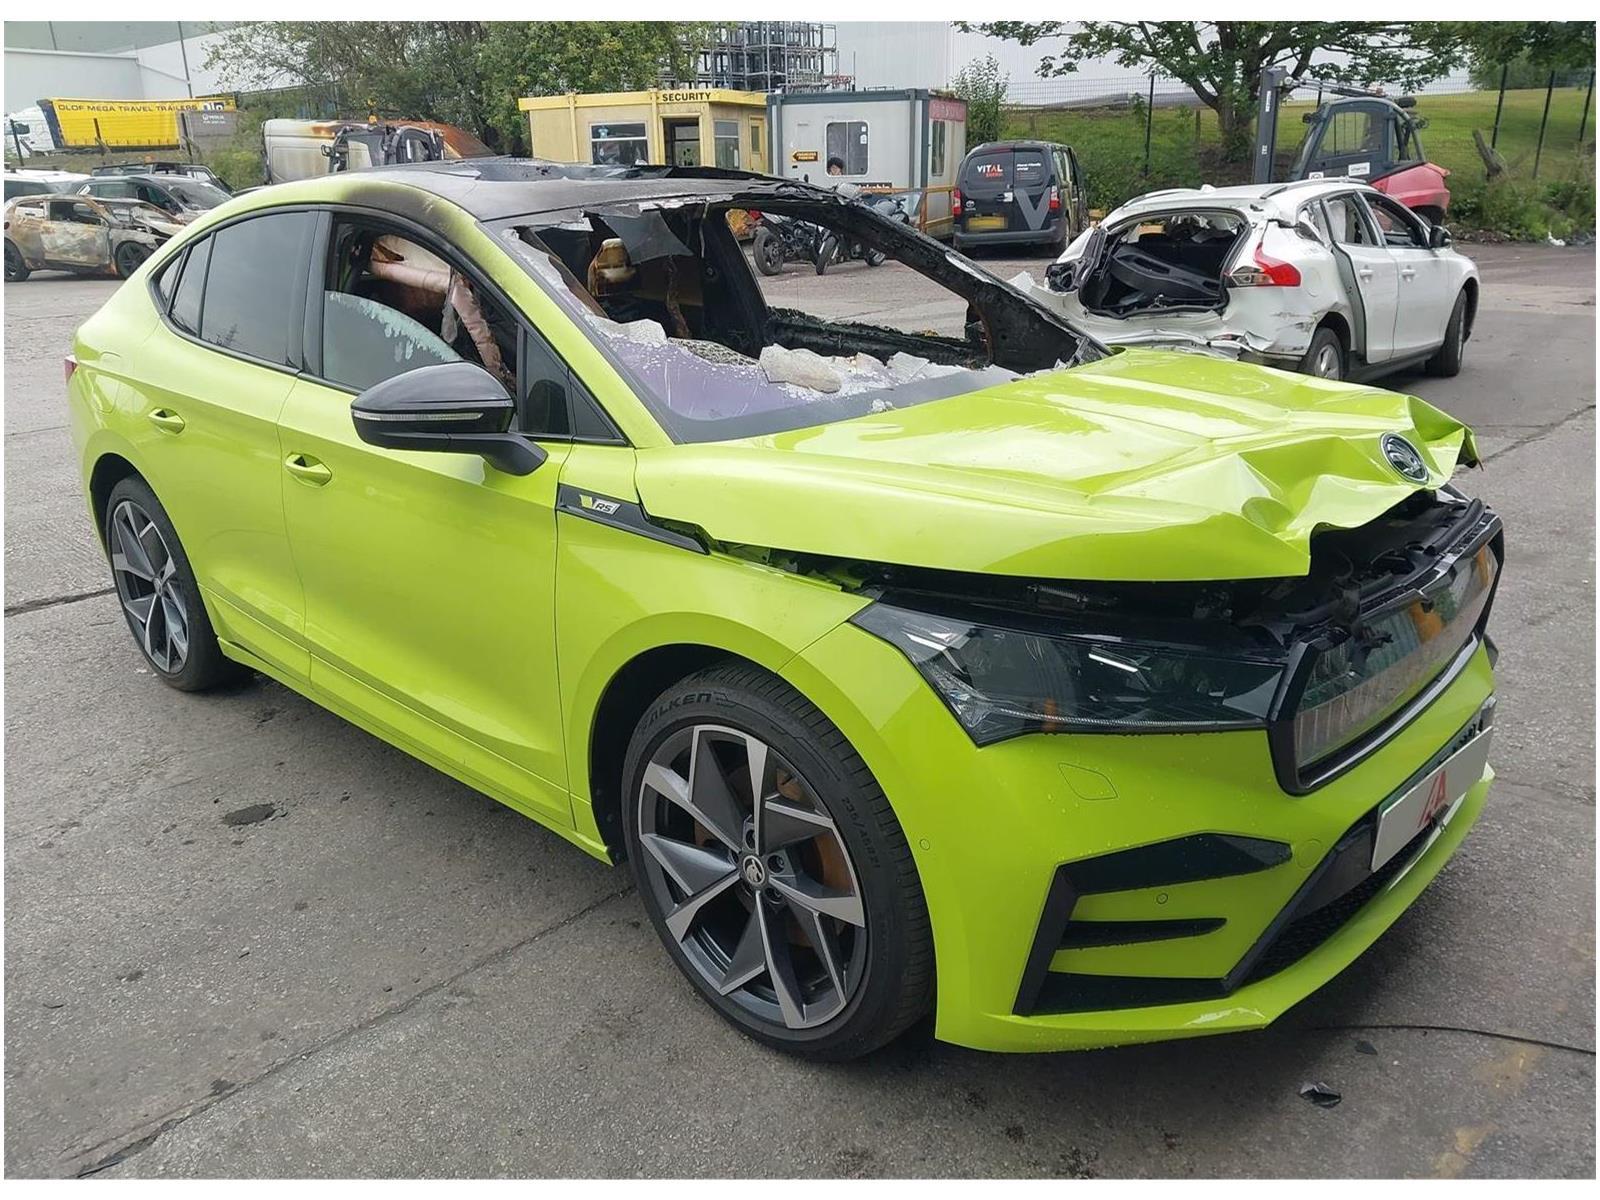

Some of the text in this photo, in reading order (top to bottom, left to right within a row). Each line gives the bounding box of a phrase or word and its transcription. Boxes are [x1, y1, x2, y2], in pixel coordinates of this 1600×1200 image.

[662, 92, 711, 102] SECURITY
[87, 104, 116, 112] MEGA
[118, 104, 153, 112] TRAVEL
[976, 164, 1003, 173] VITAL
